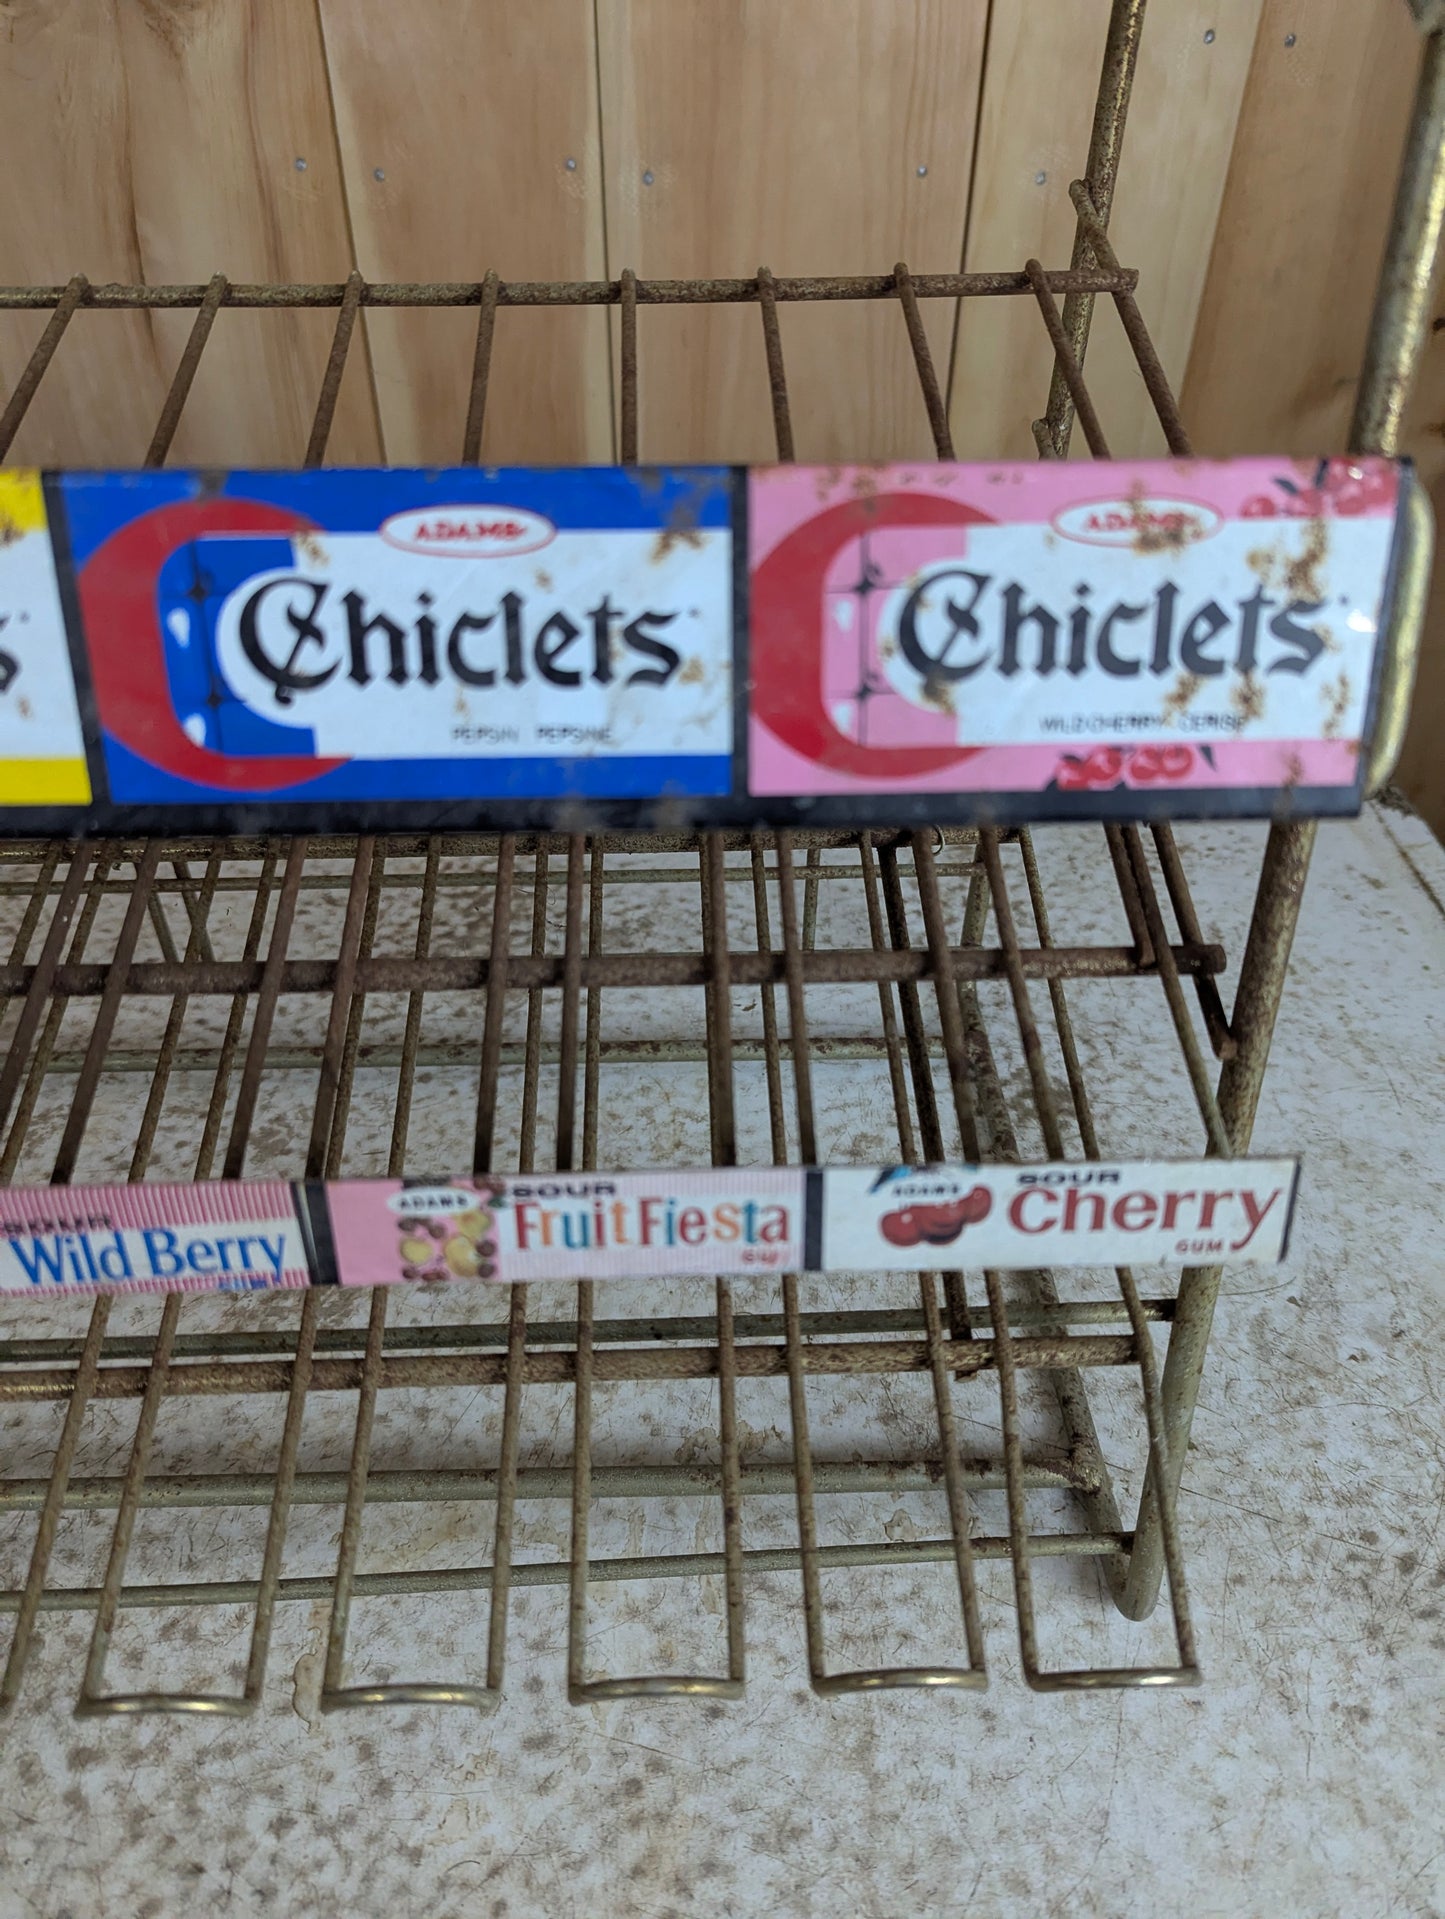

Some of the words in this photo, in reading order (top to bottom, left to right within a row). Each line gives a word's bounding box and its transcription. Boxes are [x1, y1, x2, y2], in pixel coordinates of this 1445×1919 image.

[237, 575, 684, 705] Chiclets
[899, 570, 1333, 681] Chiclets
[513, 1181, 617, 1198] SOUR
[1018, 1170, 1121, 1185] SOUR
[1007, 1186, 1284, 1252] Cherry
[1175, 1238, 1224, 1255] GUM
[9, 1230, 133, 1284] Wild
[142, 1227, 286, 1283] Berry
